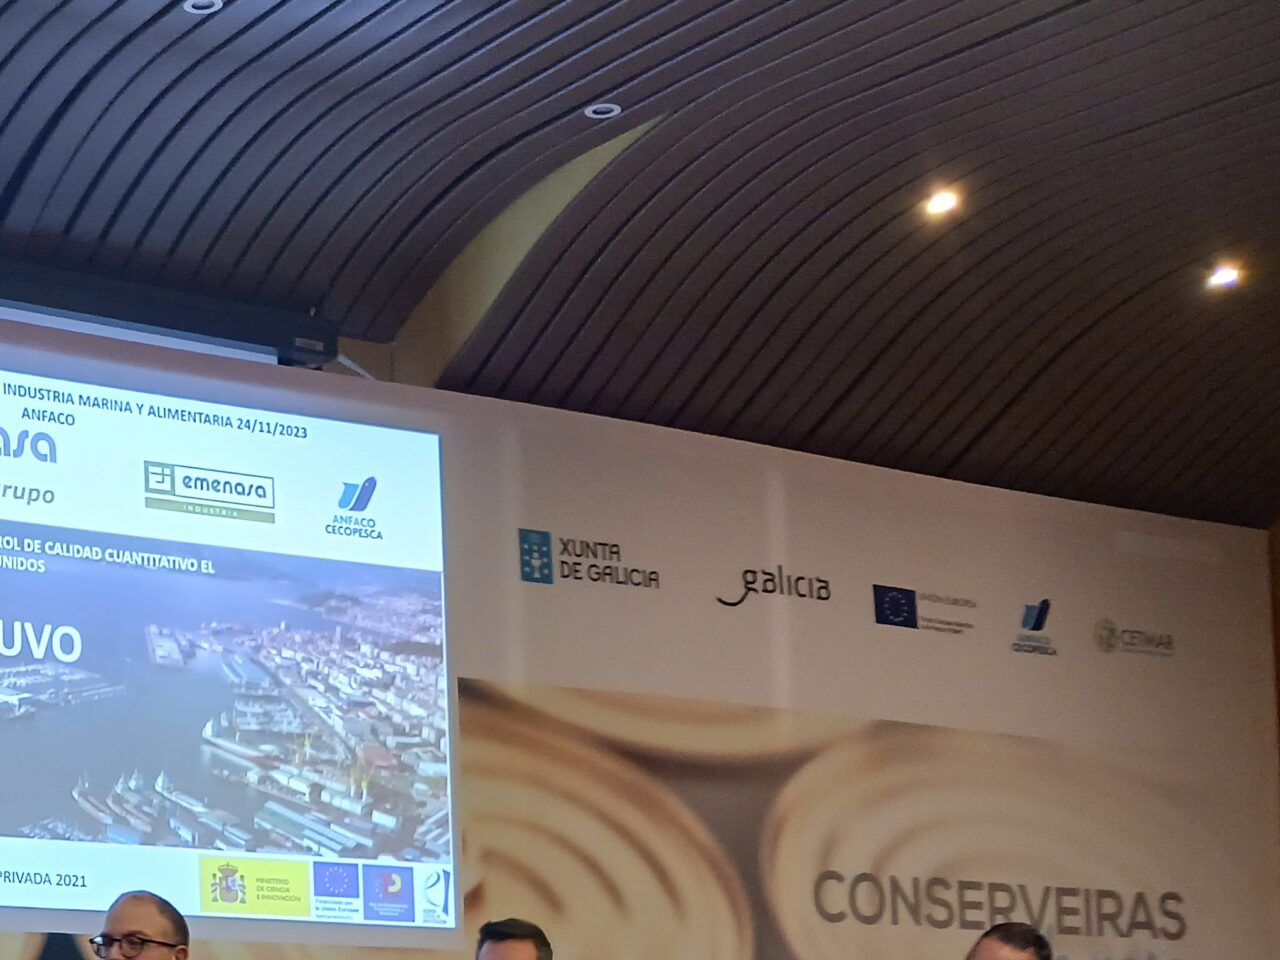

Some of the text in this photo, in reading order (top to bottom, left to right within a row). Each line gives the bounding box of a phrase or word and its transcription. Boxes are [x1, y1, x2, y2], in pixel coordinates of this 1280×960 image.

[3, 382, 75, 406] INDUSTRIA
[78, 394, 133, 414] MARINA
[137, 403, 145, 416] Y
[147, 405, 234, 429] ALIMENTARIA
[236, 417, 308, 439] 24/11/2023
[21, 407, 75, 426] ANFACO
[182, 475, 267, 499] emenasa
[183, 504, 239, 518] INDUSTRIA
[332, 514, 376, 529] ANFACO
[325, 525, 383, 540] CECOPESCA
[24, 538, 41, 553] DE
[44, 541, 102, 560] CALIDAD
[105, 548, 198, 572] CUANTITATIVO
[201, 560, 215, 574] EL
[559, 537, 621, 562] XUNTA
[559, 561, 660, 589] DE GALICIA
[716, 564, 831, 607] galicia
[55, 874, 87, 888] 2021
[813, 869, 1187, 941] CONSERVEIRAS
